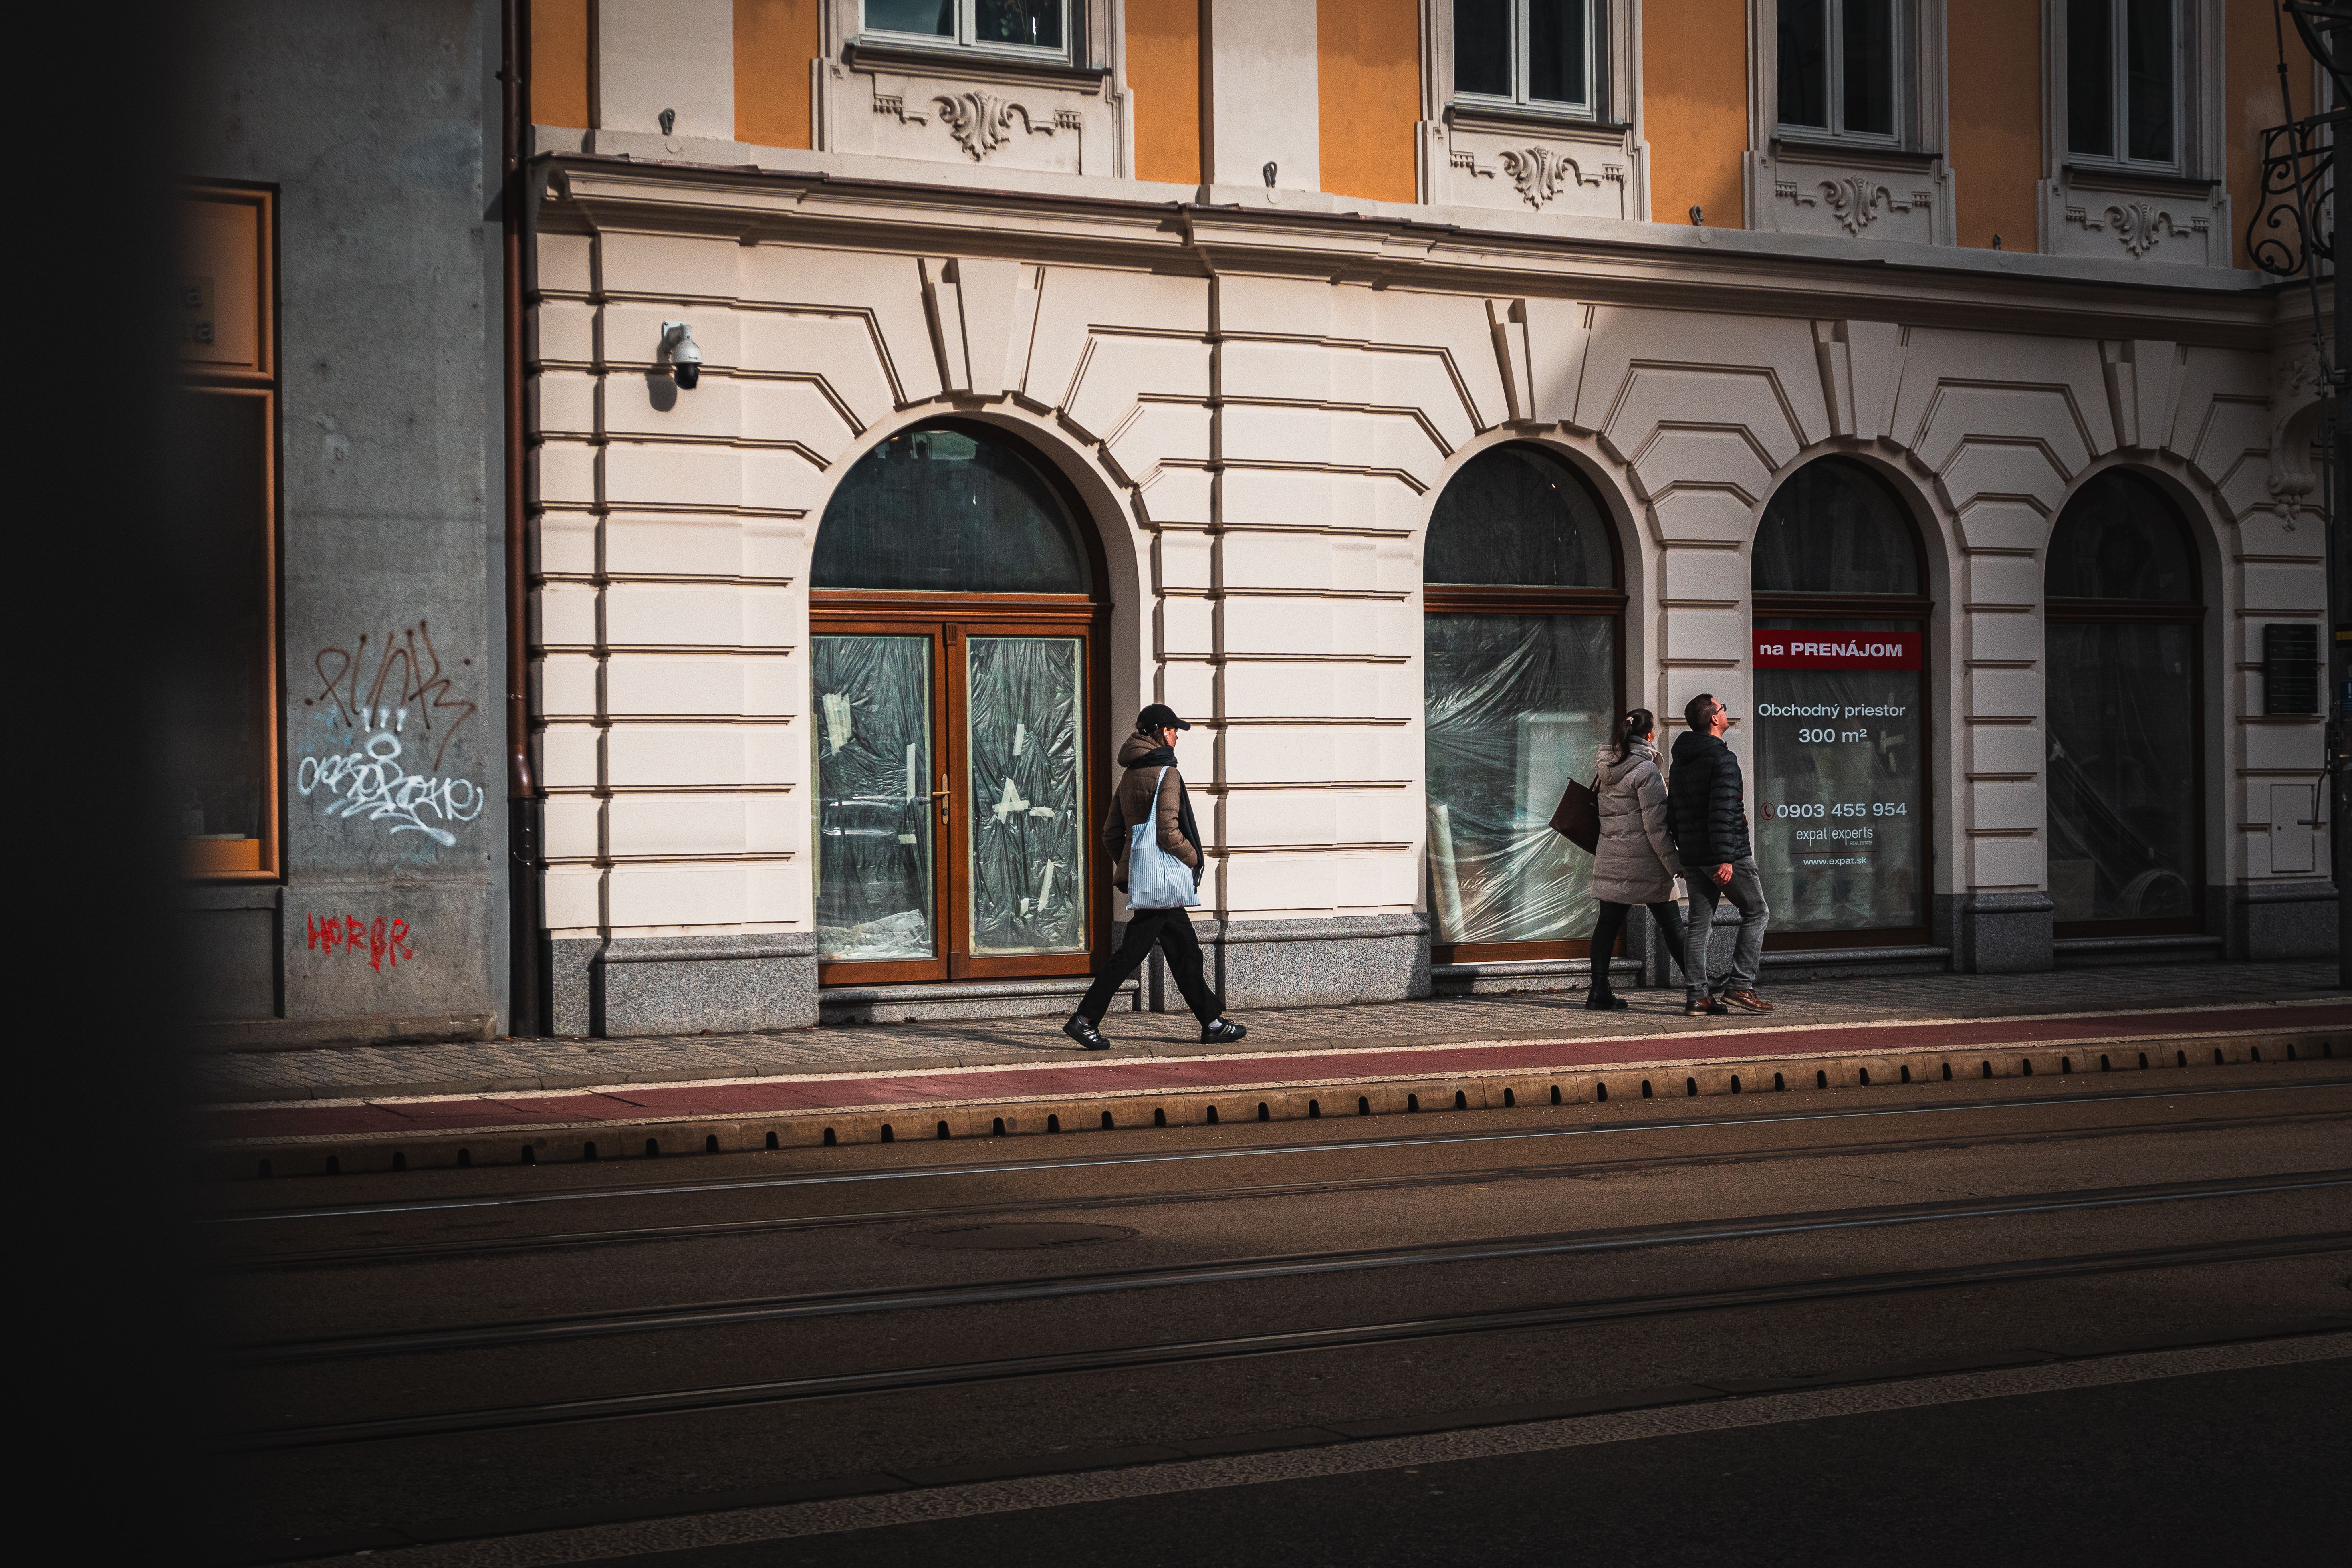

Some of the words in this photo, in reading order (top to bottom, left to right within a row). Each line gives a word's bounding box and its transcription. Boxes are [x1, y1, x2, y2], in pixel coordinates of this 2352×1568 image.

[1760, 644, 1784, 655] na
[1791, 640, 1902, 657] PRENÁJOM
[1759, 704, 1840, 719] Obchodný
[1845, 704, 1906, 719] priestor
[1799, 729, 1835, 742] 300
[1842, 729, 1867, 742] m²
[1777, 804, 1825, 818] 0903
[1831, 803, 1866, 817] 455
[1872, 803, 1907, 816] 954
[1796, 827, 1827, 846] expat
[1832, 827, 1873, 846] experts
[1803, 857, 1867, 866] www.expat.sk
